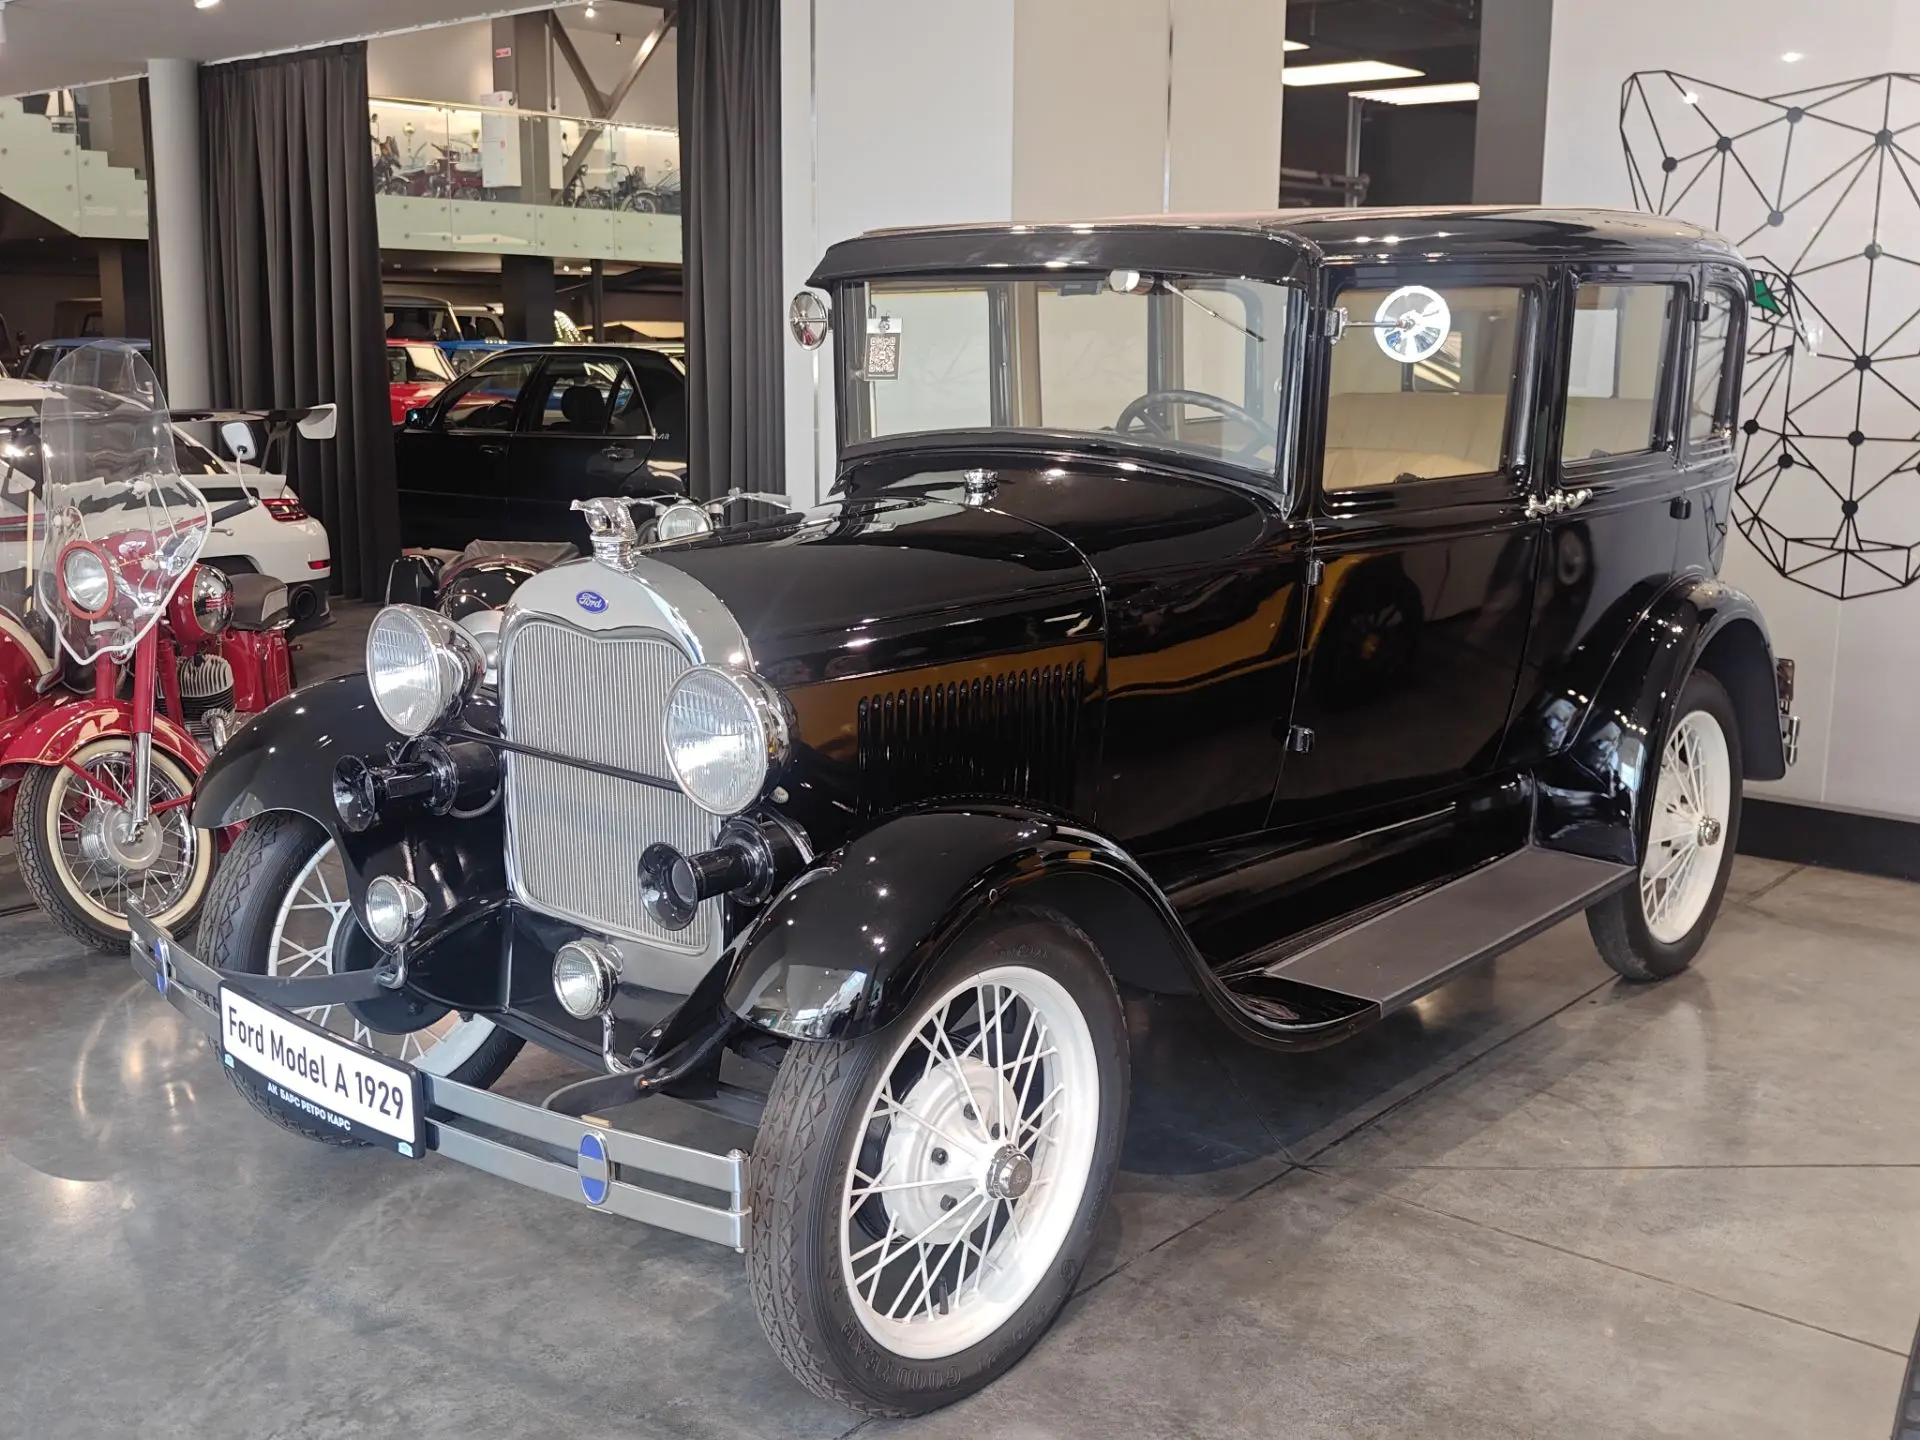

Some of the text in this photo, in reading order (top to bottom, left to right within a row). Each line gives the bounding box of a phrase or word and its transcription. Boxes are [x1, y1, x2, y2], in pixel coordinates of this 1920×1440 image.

[579, 592, 603, 608] Ford
[228, 1006, 404, 1120] Ford Model A 1929
[267, 1081, 352, 1131] АК БАРС РЕТРО КАРС
[841, 1315, 961, 1391] GOODYEAR
